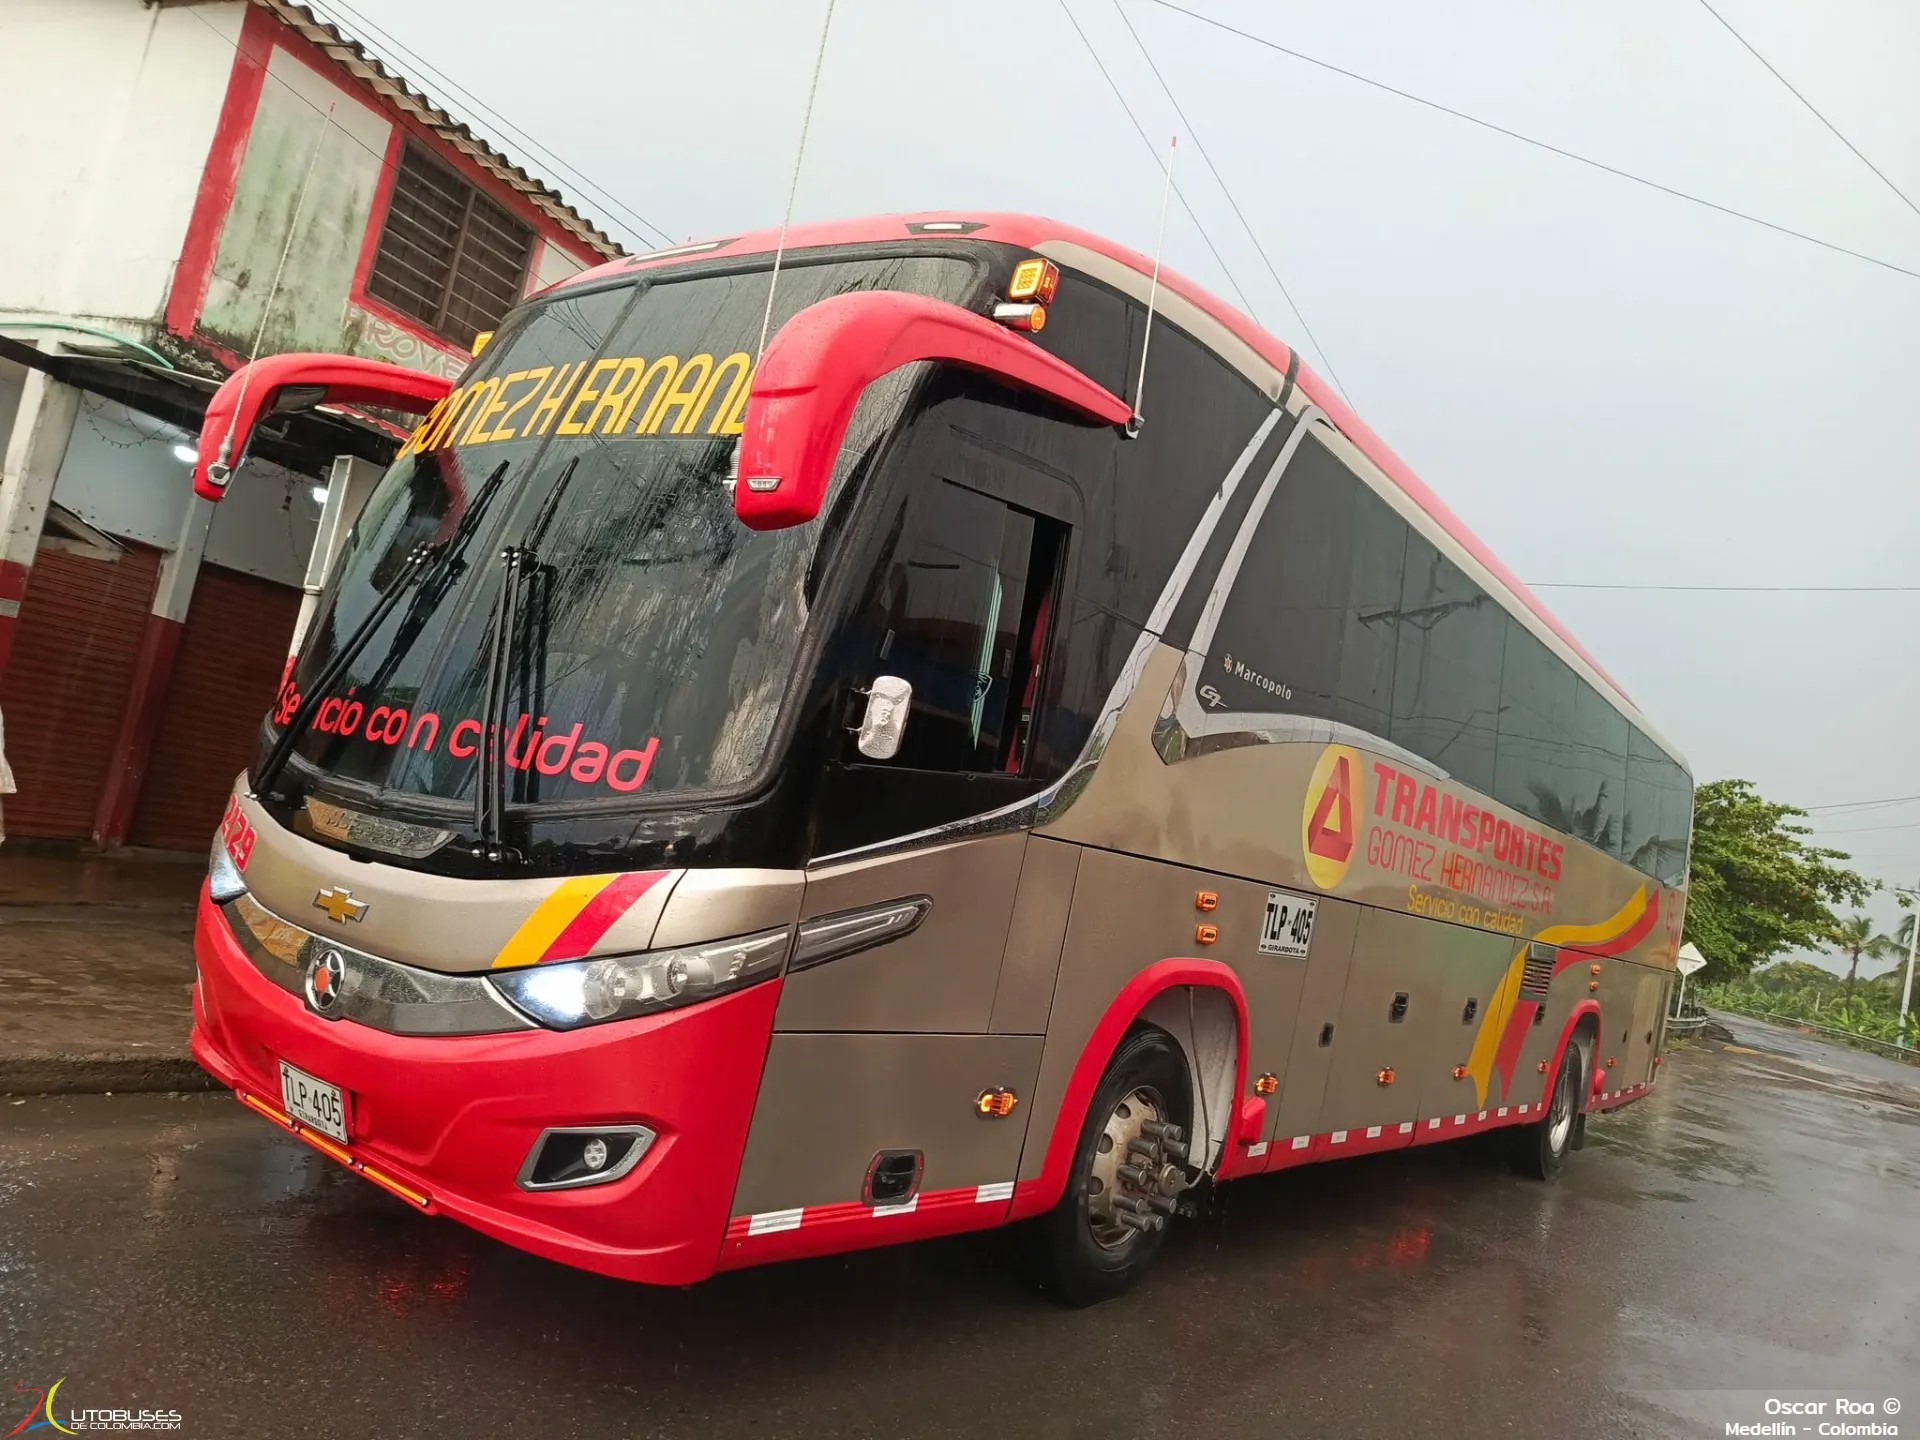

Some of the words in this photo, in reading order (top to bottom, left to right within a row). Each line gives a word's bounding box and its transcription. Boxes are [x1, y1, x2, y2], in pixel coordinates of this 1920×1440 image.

[1234, 661, 1292, 700] Marcopolo
[274, 681, 363, 736] Seicio
[365, 705, 440, 752] con
[449, 713, 660, 792] clidad
[1373, 761, 1564, 882] TRANSPORTES
[1367, 825, 1436, 882] GOMEZ
[1440, 849, 1530, 909] HERNANDEZ
[1264, 902, 1288, 941] TLP
[1290, 907, 1313, 945] 405
[1407, 884, 1455, 919] Servicio
[1458, 904, 1480, 925] con
[1483, 908, 1524, 935] calidad
[1268, 944, 1299, 954] GIRARDOTA
[282, 1072, 307, 1109] TLP
[313, 1089, 341, 1126] 405
